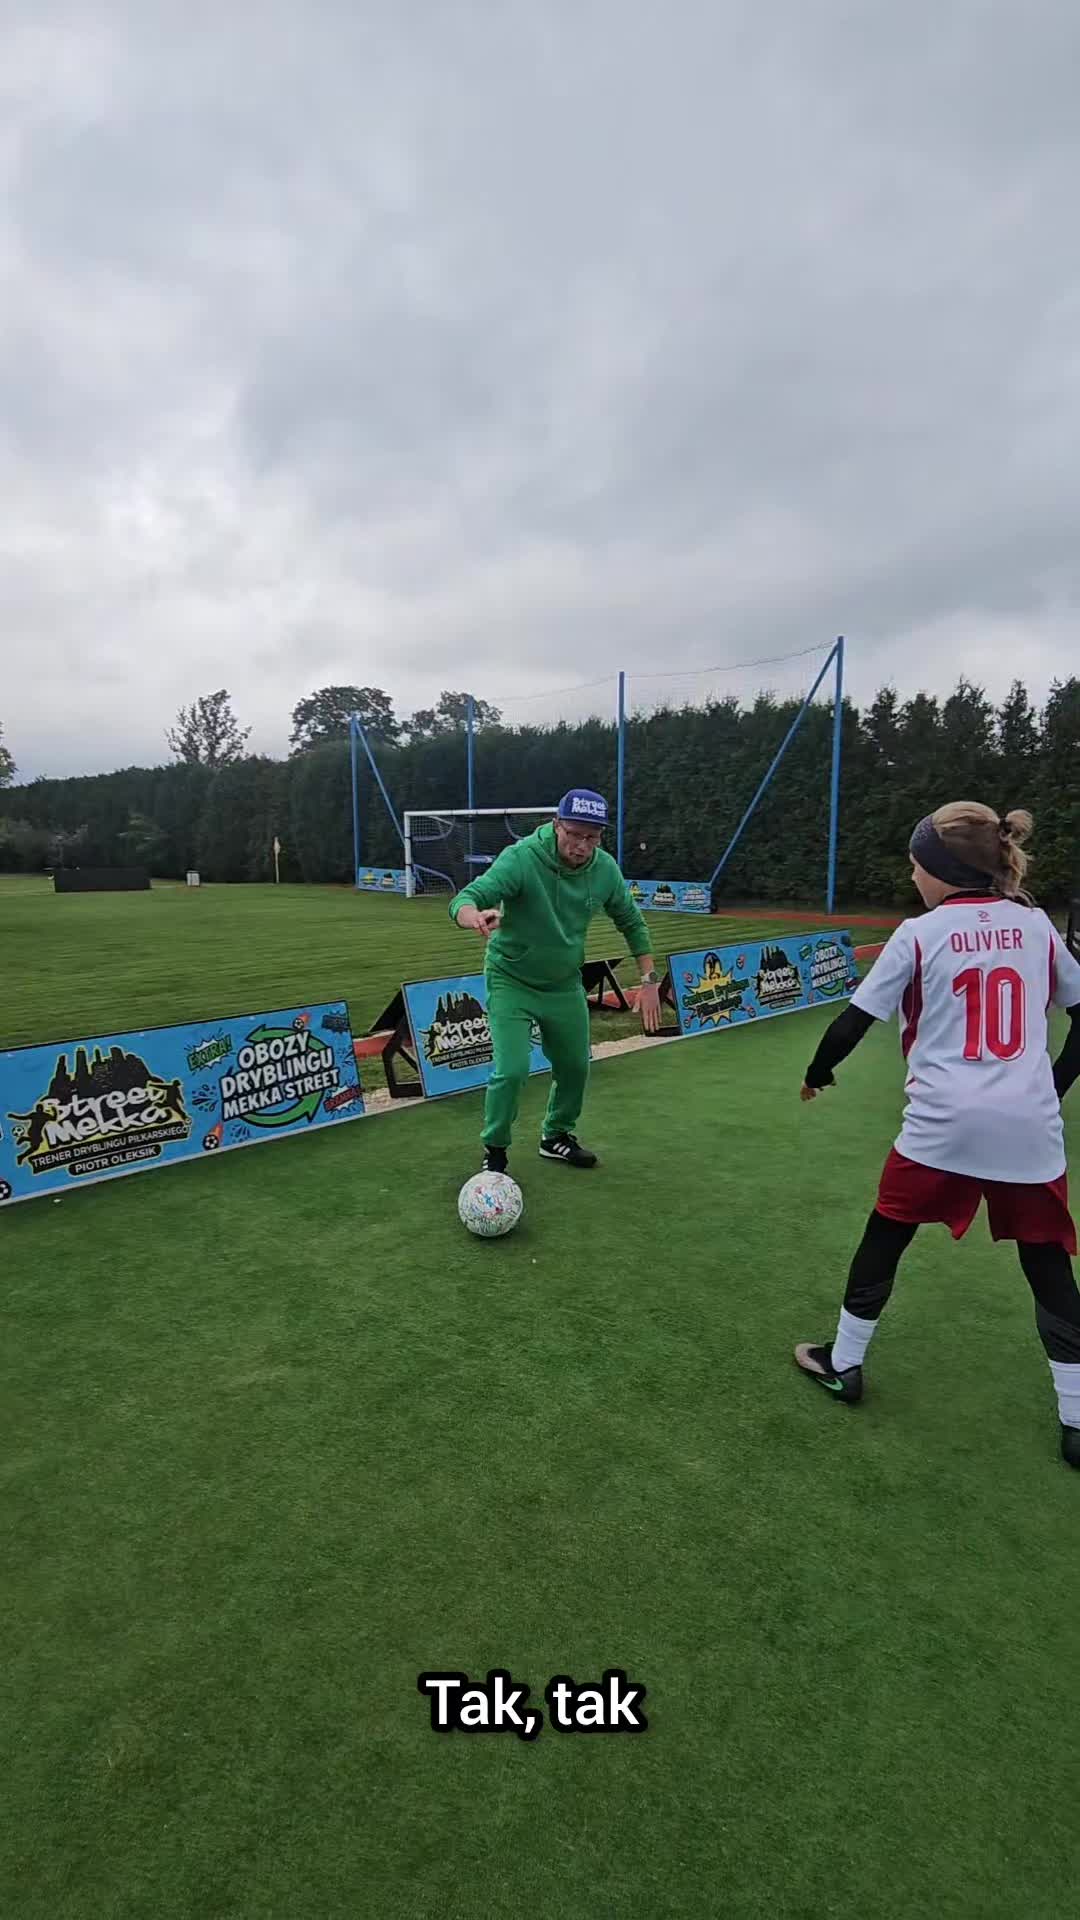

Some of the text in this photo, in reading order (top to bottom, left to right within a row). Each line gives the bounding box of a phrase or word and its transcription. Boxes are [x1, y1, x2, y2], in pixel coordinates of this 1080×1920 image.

[951, 928, 1023, 953] OLIVIER
[952, 966, 1026, 1062] 10
[239, 1031, 309, 1069] OBOZY
[221, 1048, 333, 1099] DRYBLINGU
[42, 1087, 166, 1121] Street
[224, 1069, 340, 1119] MEKKA STREET
[45, 1105, 169, 1145] Mekka
[32, 1150, 72, 1168] TRENER
[73, 1137, 126, 1158] DRYBLINGU
[75, 1146, 157, 1174] PIOTR OLEKSIK
